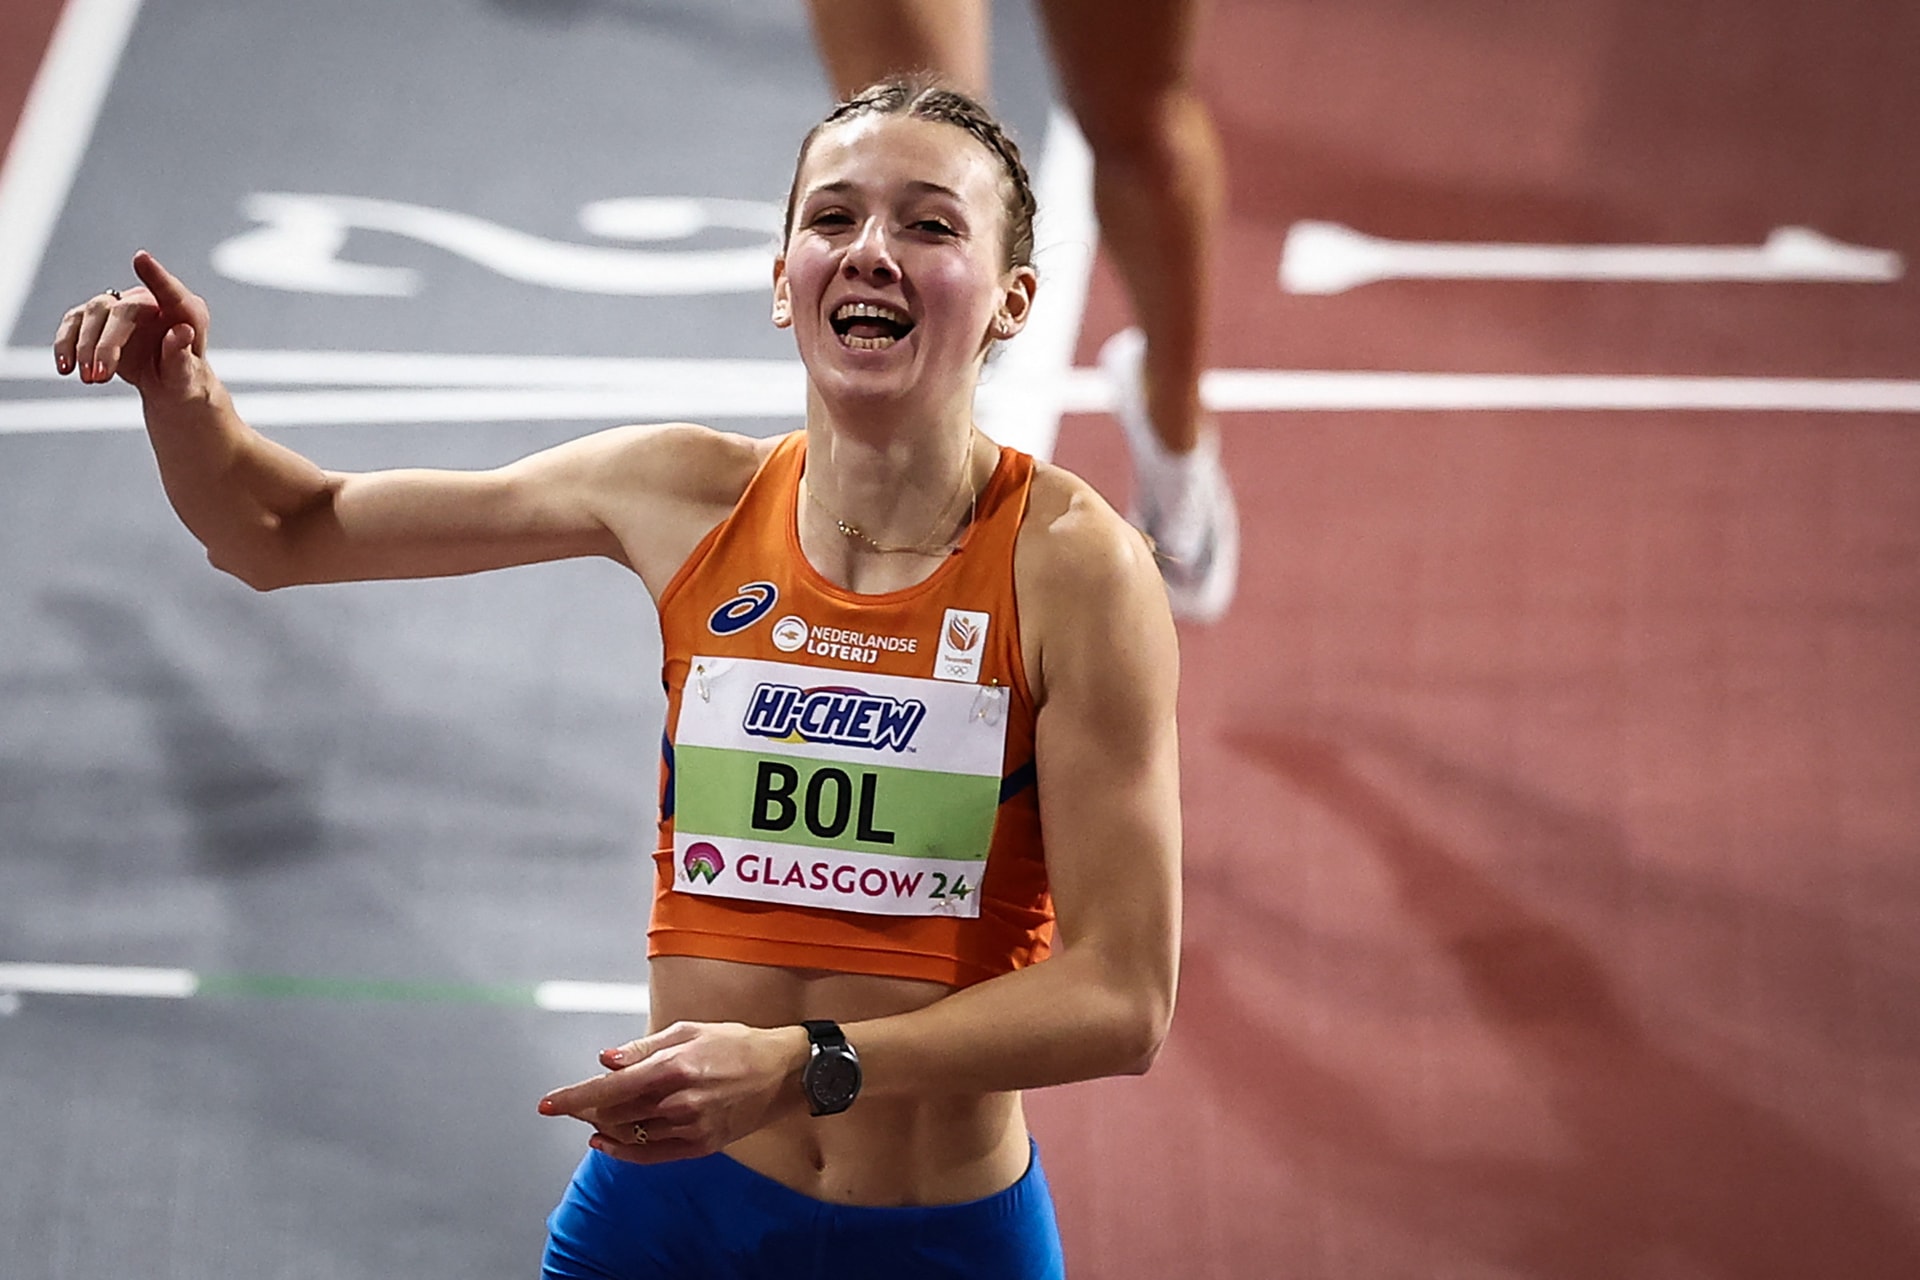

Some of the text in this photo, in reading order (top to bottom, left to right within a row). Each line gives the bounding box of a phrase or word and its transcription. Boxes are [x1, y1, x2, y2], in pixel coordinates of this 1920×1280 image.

[807, 638, 878, 664] LOTERIJ
[810, 625, 917, 653] NEDERLANDSE
[743, 683, 926, 753] HI-CHEW
[751, 761, 895, 844] BOL
[736, 855, 969, 901] GLASGOW 24
